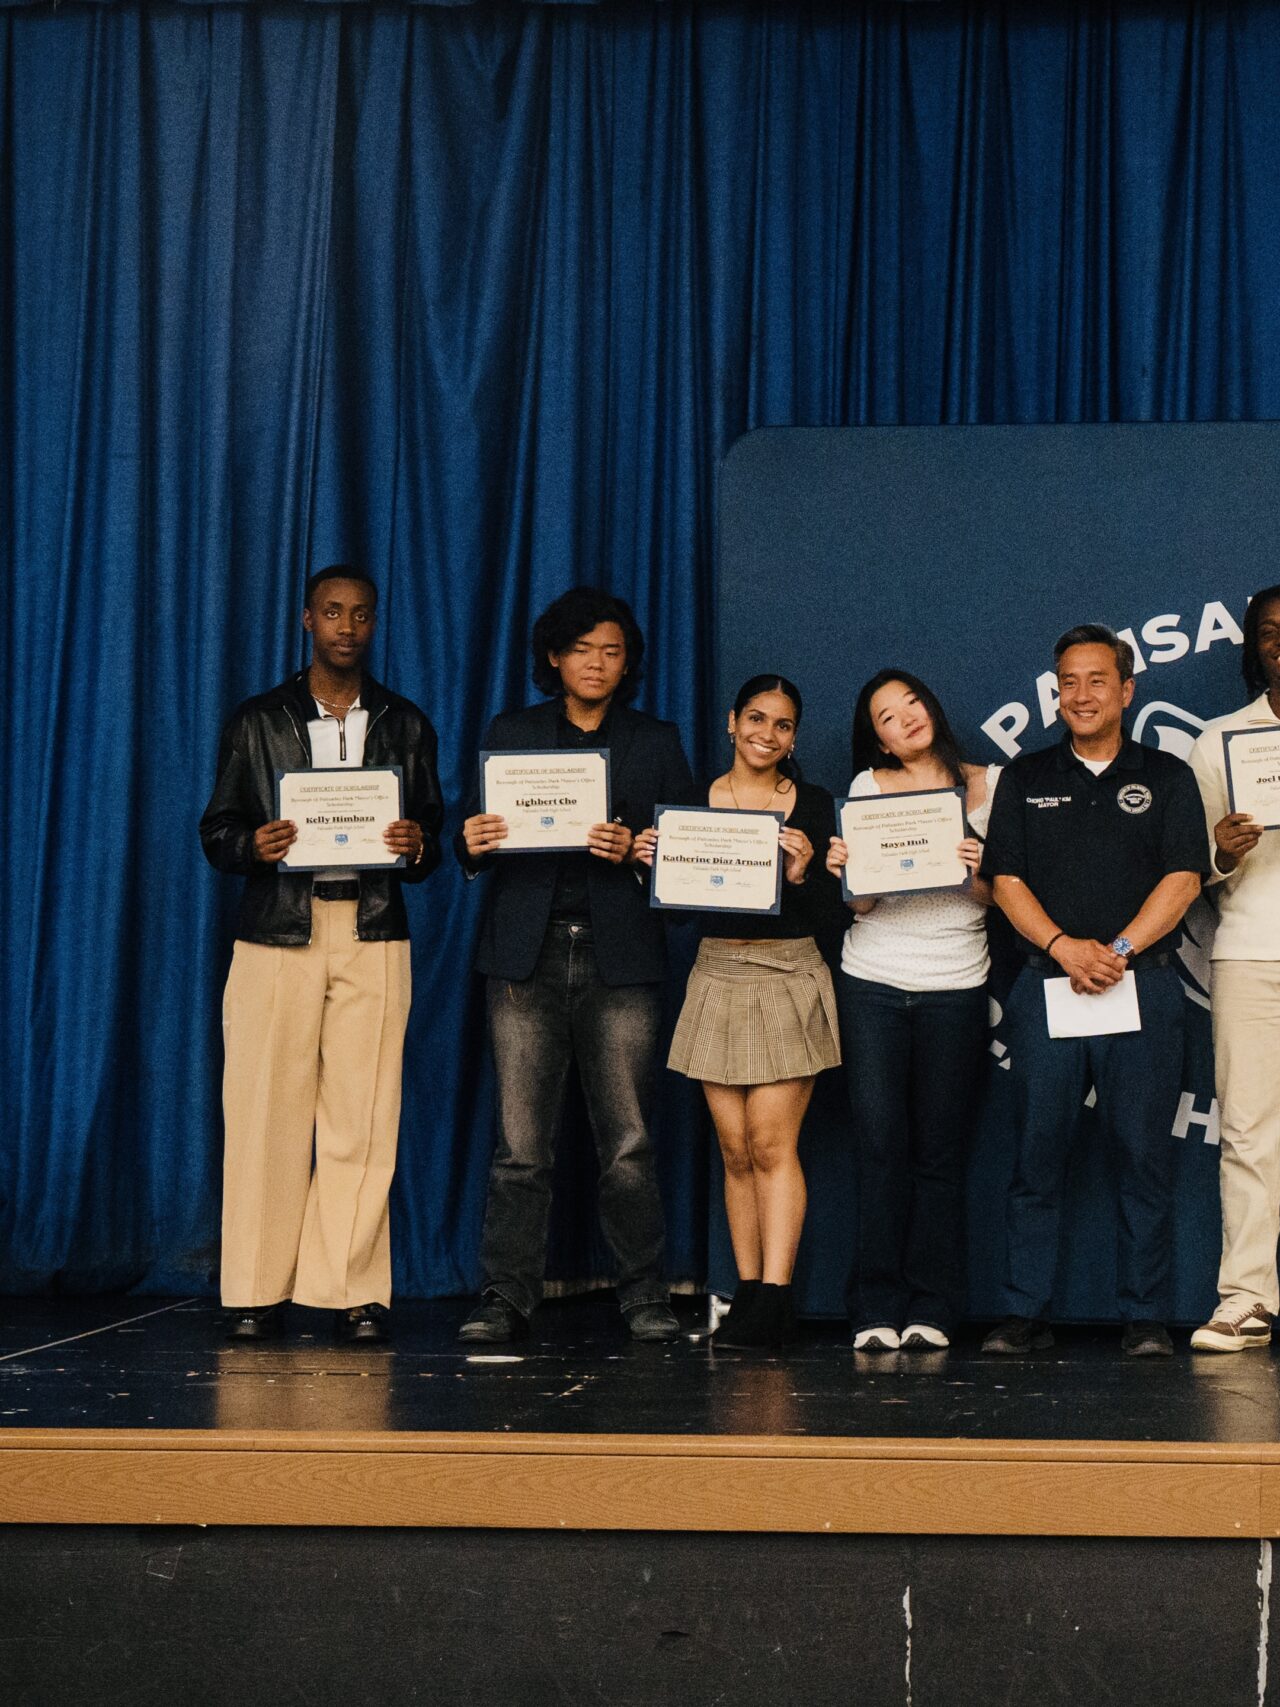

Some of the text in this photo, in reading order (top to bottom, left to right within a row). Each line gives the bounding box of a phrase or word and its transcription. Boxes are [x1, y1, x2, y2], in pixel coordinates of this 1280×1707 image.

[1256, 775, 1276, 784] Joel
[516, 798, 557, 807] Lighbert
[306, 816, 329, 824] Kelly
[900, 838, 928, 847] Huh
[663, 855, 710, 864] Katherine
[735, 859, 772, 867] Arnaud
